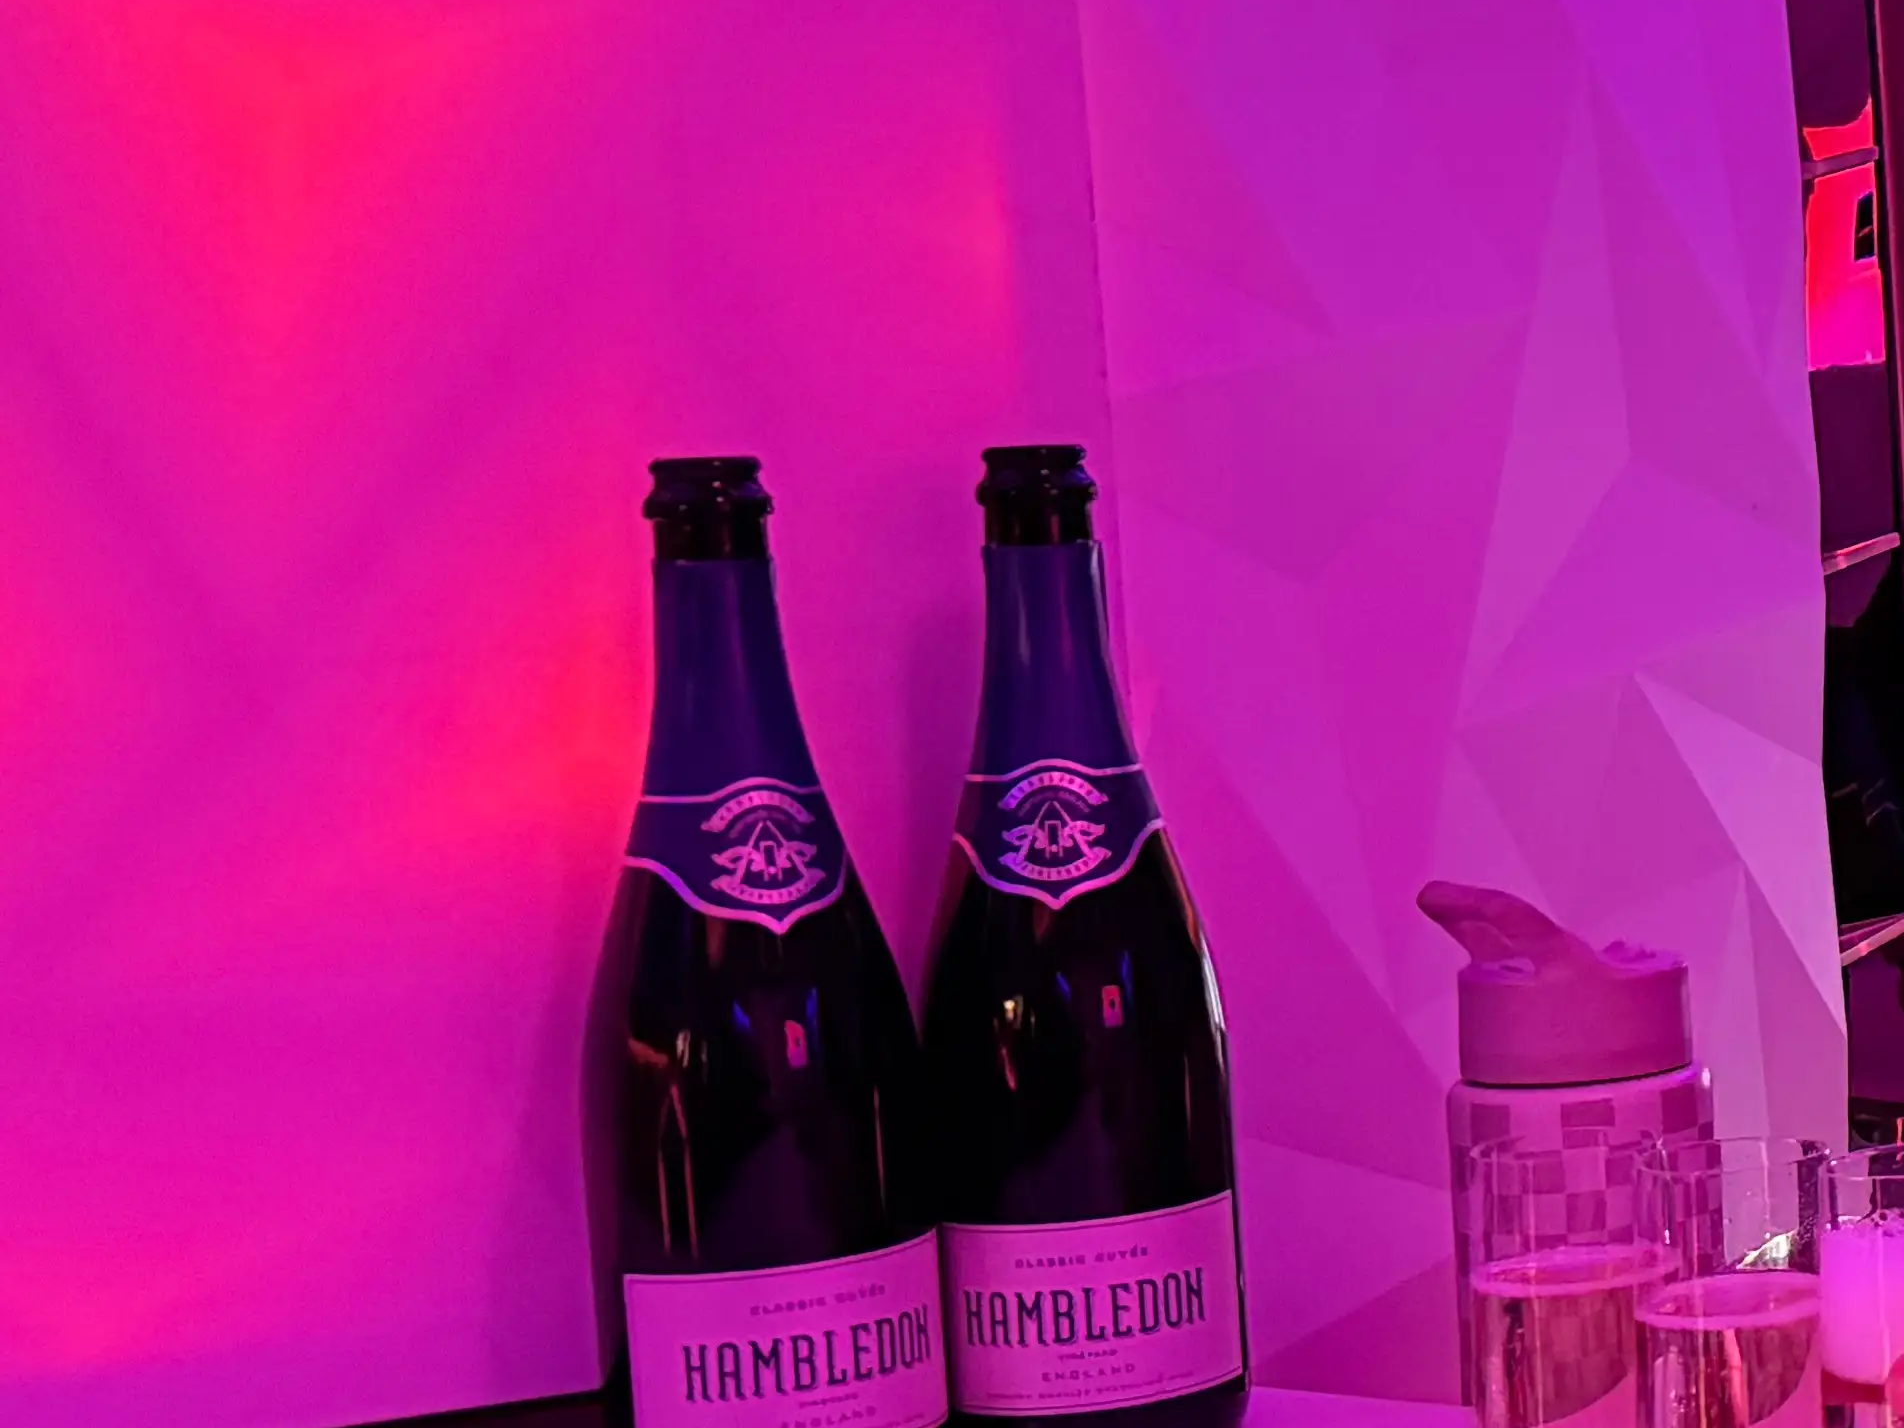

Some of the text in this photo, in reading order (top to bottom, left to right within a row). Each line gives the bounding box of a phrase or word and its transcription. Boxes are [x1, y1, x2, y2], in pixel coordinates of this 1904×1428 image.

[963, 1267, 1207, 1349] HAMBLEDON
[682, 1303, 932, 1404] HAMBLEDON
[1042, 1363, 1137, 1383] ENGLAND
